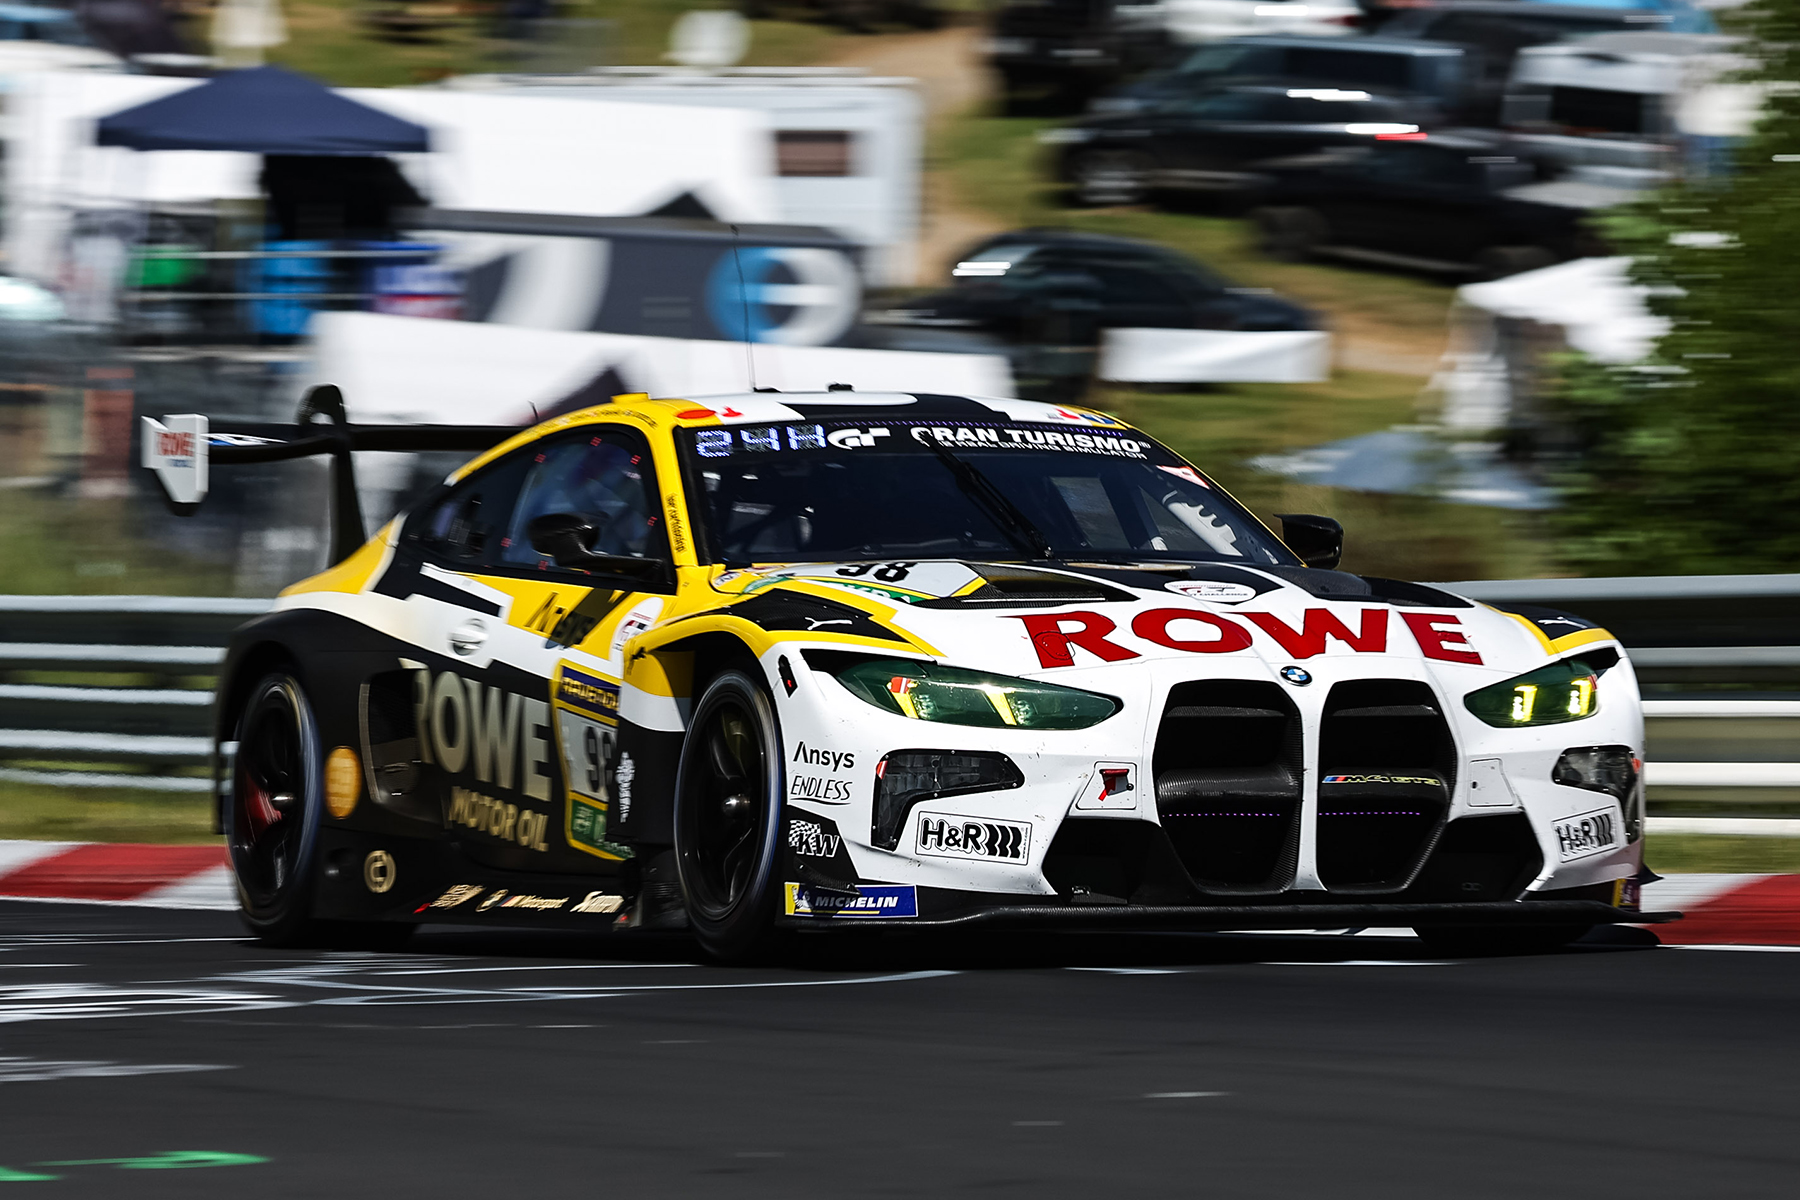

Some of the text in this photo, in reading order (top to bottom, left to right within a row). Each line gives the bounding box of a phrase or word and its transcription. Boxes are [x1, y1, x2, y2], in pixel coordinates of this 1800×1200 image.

[910, 427, 999, 447] GRAN
[996, 607, 1485, 669] ROWE
[399, 657, 552, 802] ROWE
[793, 741, 855, 772] Ansys
[791, 775, 853, 801] ENDLESS
[452, 785, 517, 842] MOTOR
[515, 808, 549, 852] OIL
[796, 833, 840, 858] KW
[921, 818, 985, 853] H&R
[1556, 819, 1596, 855] H&R
[814, 896, 899, 908] MICHELIN
